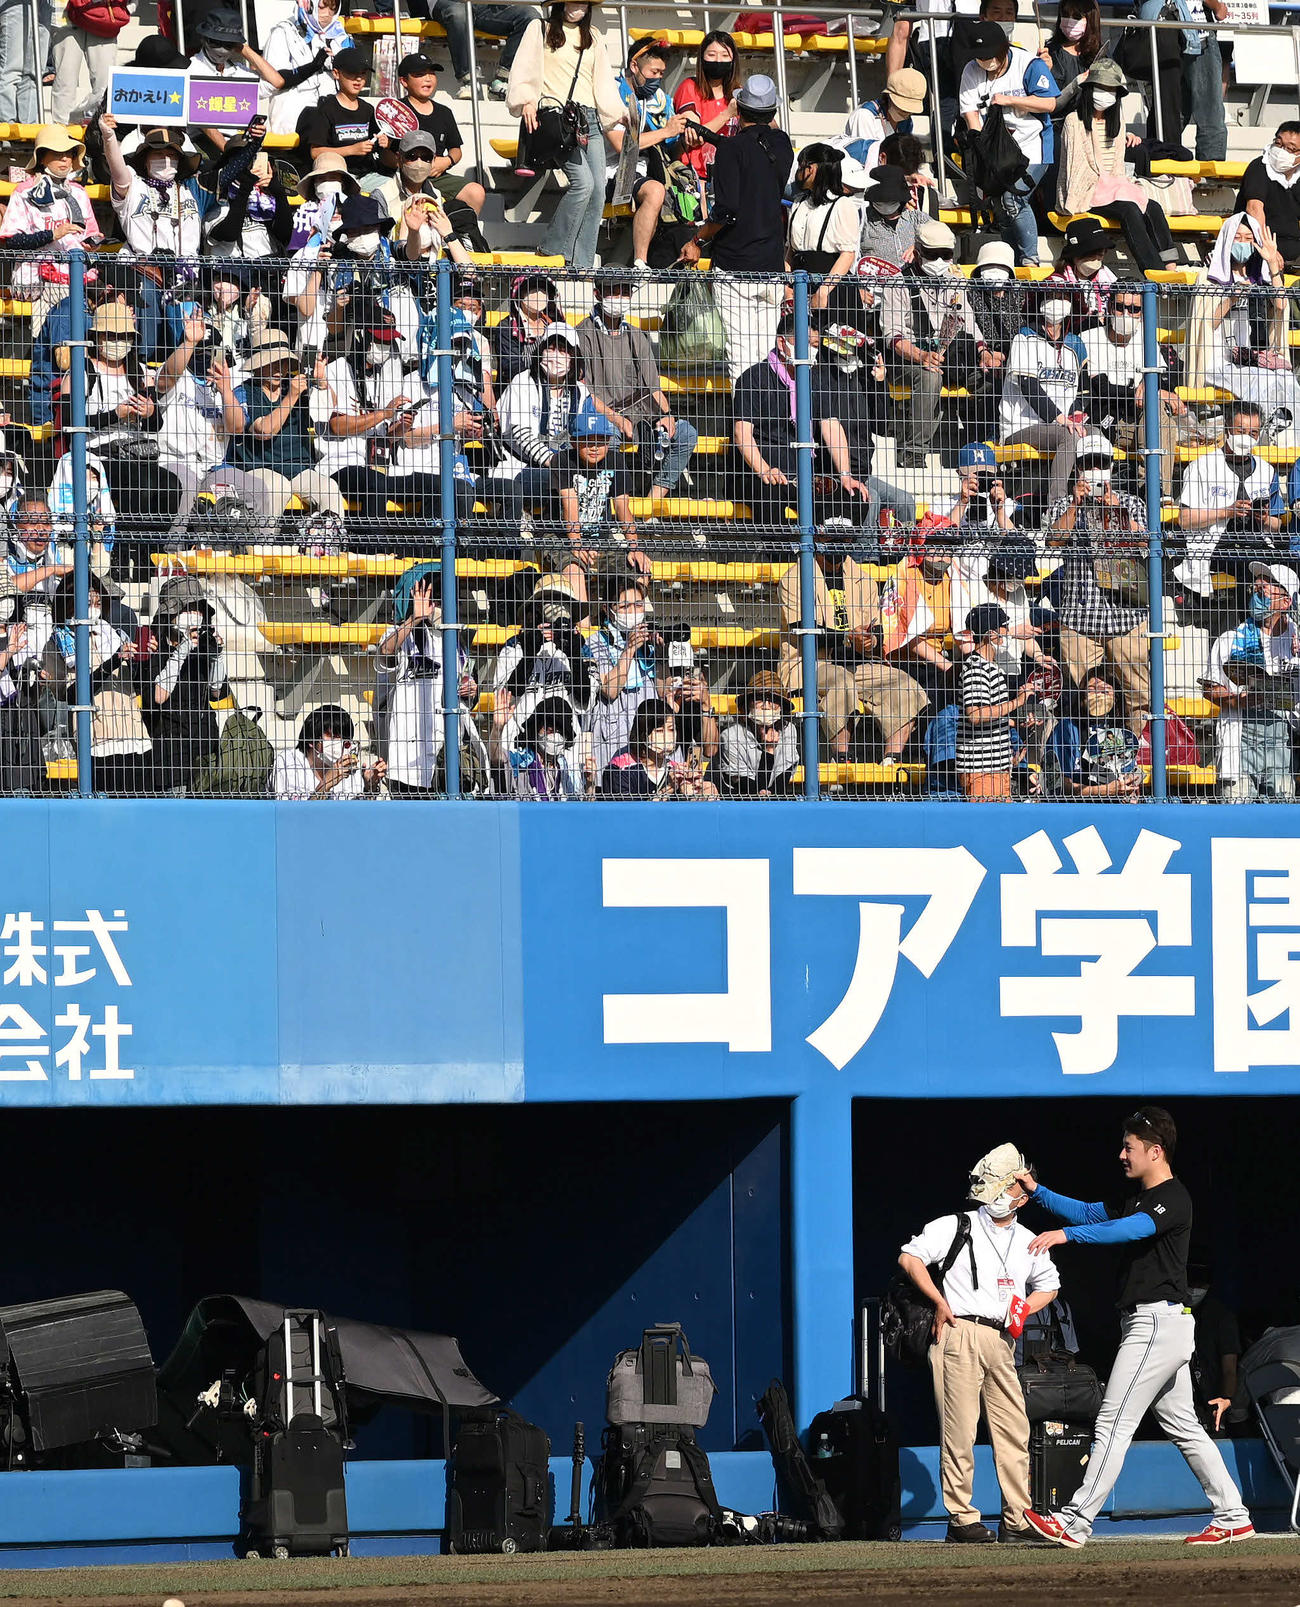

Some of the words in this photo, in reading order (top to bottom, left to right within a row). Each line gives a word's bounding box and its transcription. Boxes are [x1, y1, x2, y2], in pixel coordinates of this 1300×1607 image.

[113, 88, 168, 104] おかえり
[208, 95, 238, 112] 輝星
[0, 909, 134, 987] 株式
[0, 1003, 136, 1081] 会社
